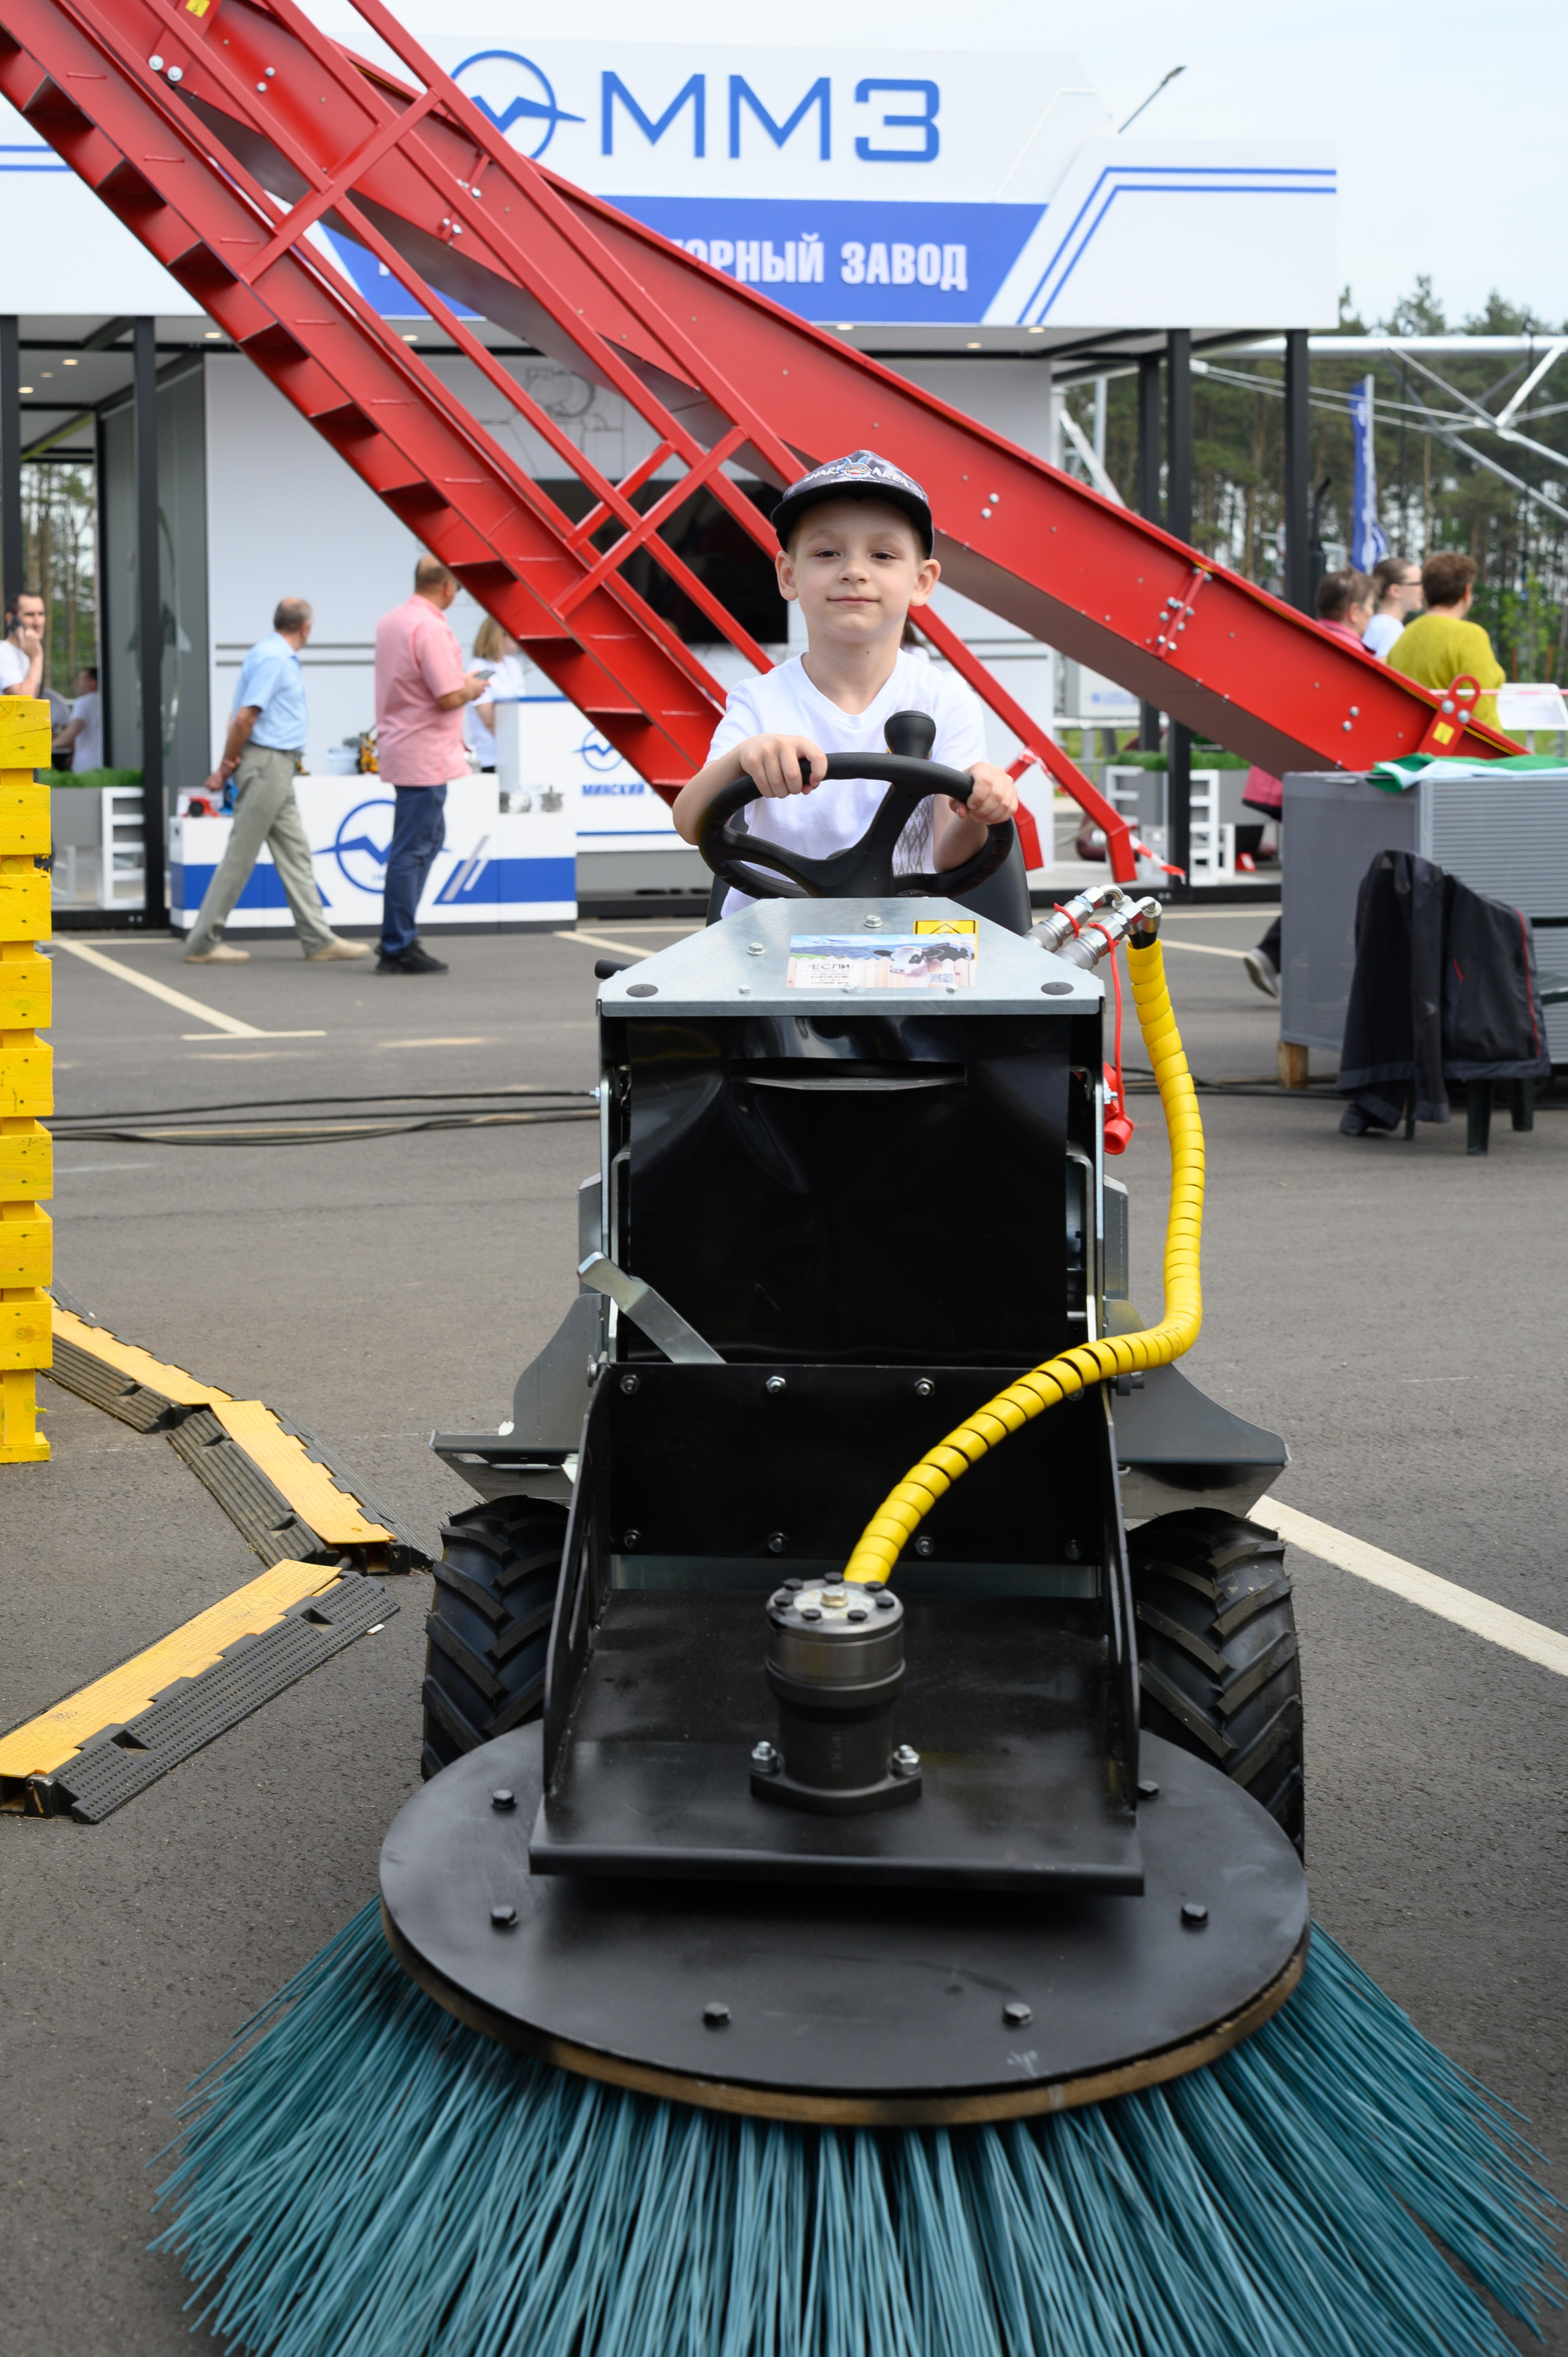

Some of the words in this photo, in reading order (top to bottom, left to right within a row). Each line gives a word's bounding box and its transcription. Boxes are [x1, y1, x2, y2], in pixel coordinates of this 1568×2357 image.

[601, 70, 940, 163] ММЗ
[840, 241, 968, 292] ЗАВОД
[582, 781, 644, 796] МИНСКИЙ
